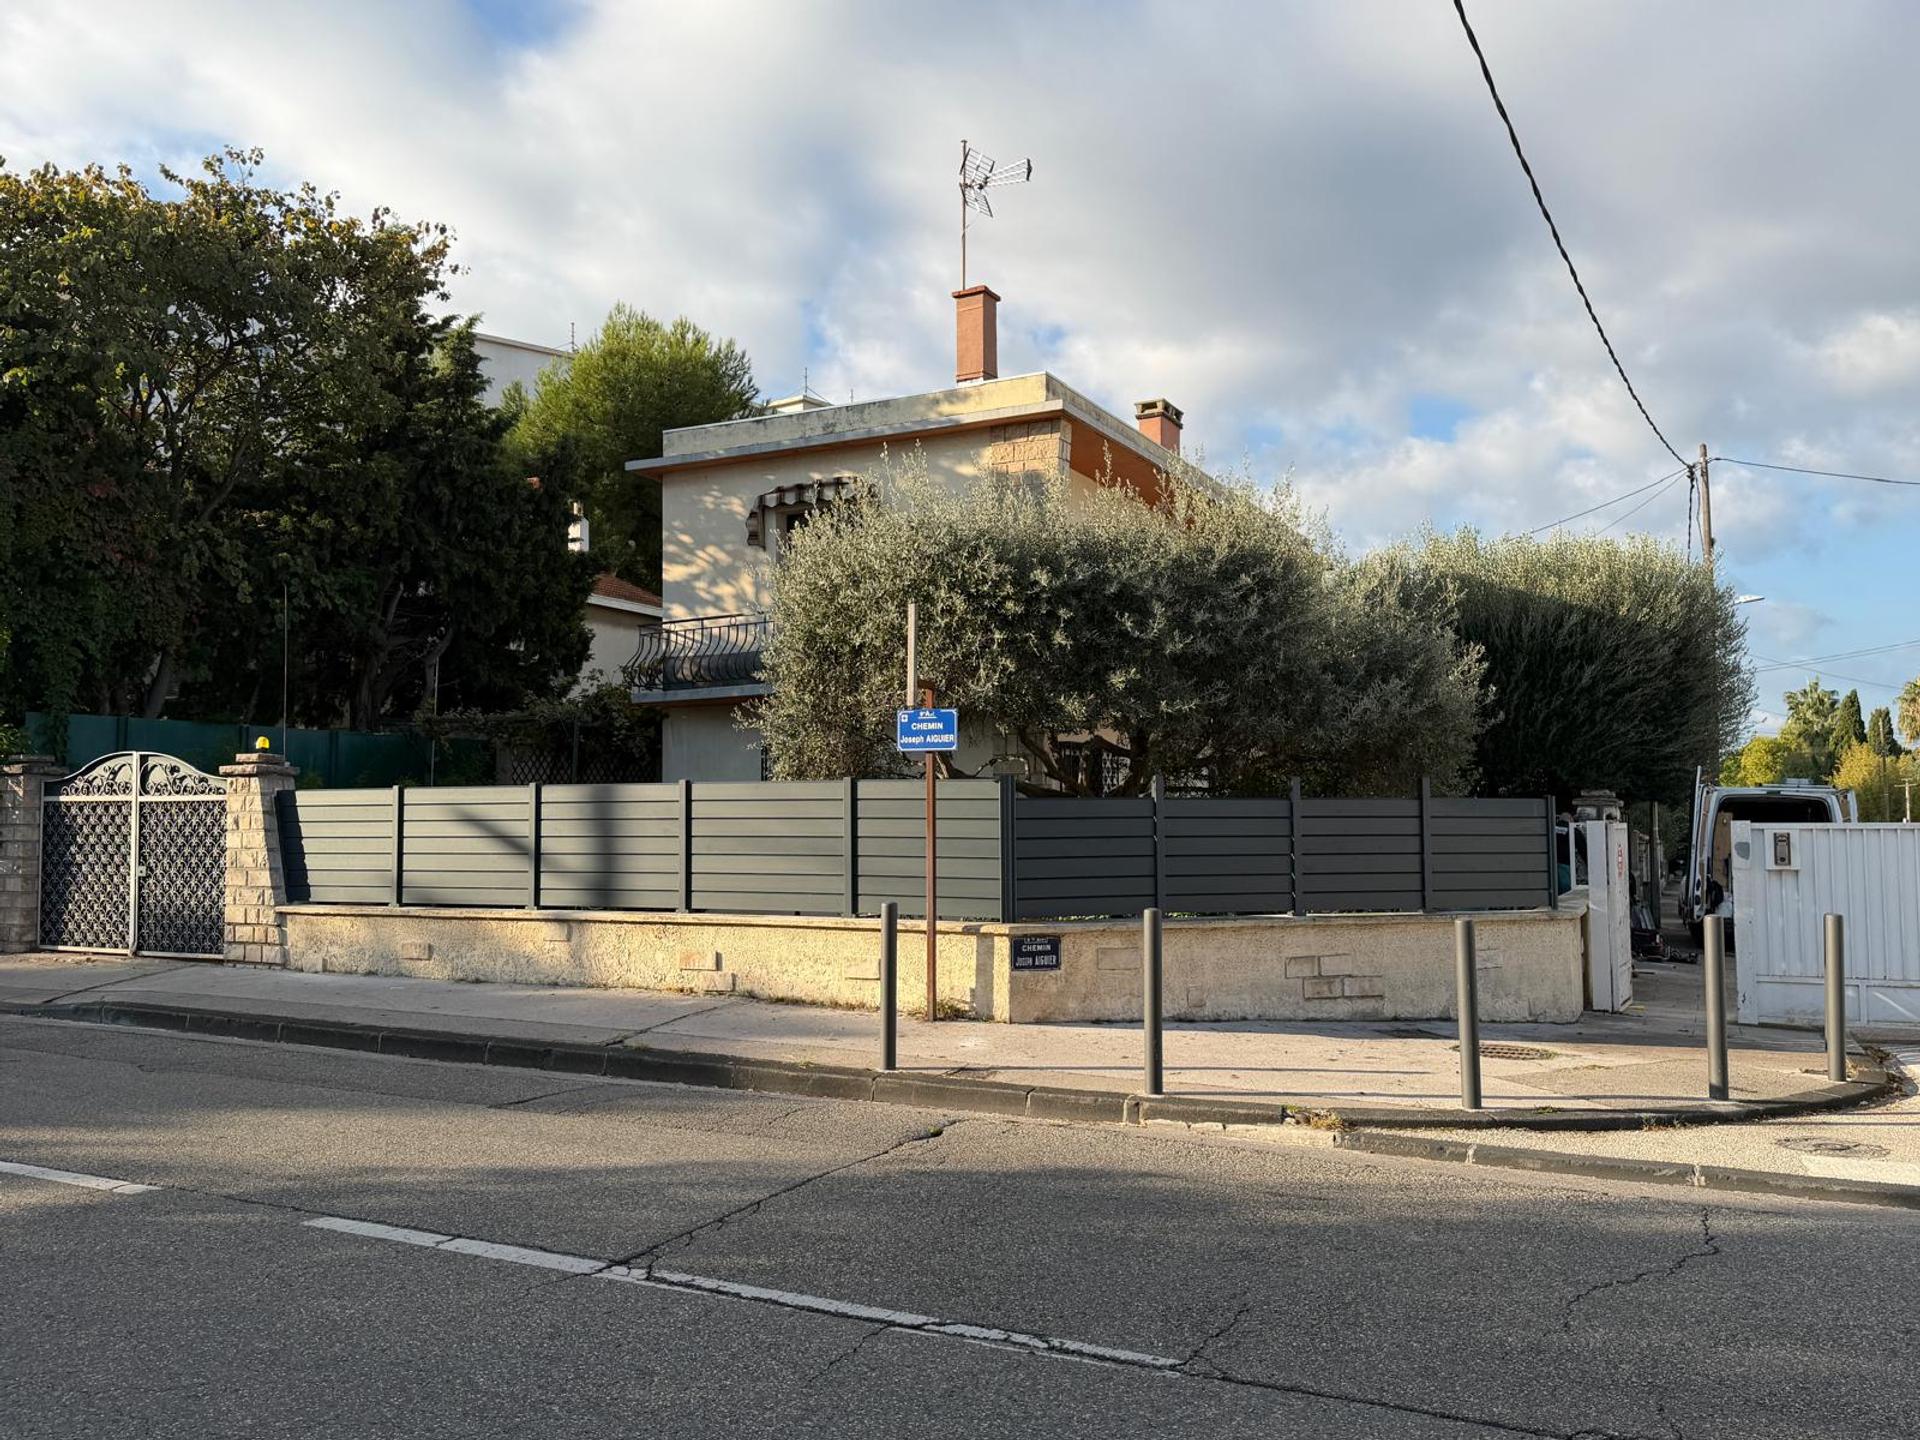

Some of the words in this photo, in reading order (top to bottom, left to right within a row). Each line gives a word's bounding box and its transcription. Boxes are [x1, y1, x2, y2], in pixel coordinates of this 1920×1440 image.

[911, 722, 944, 730] CHEMIN
[900, 735, 925, 744] Joseph
[926, 734, 954, 743] AIGUIER
